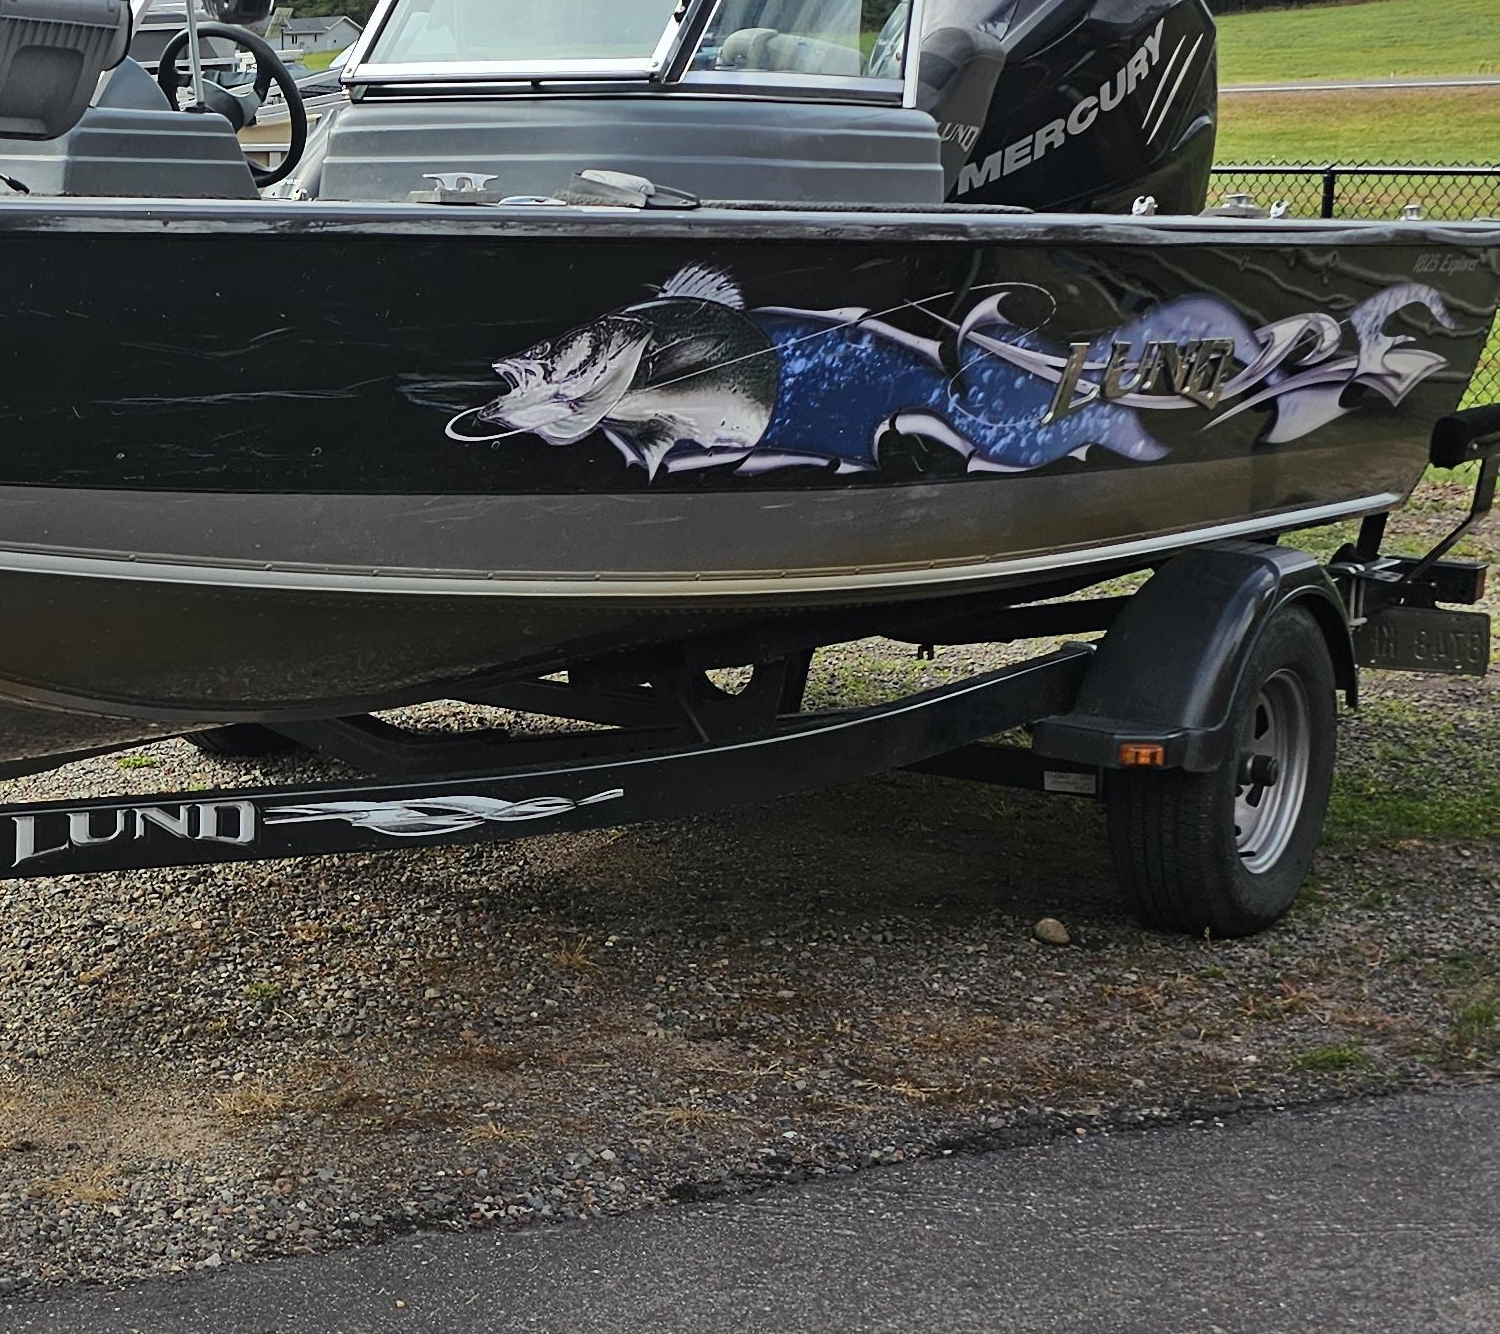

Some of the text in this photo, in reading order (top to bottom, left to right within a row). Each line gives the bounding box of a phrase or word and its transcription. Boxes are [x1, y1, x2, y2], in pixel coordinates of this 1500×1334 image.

[957, 17, 1165, 196] MERCURY
[1040, 336, 1235, 426] LUND
[11, 800, 255, 867] LUND
